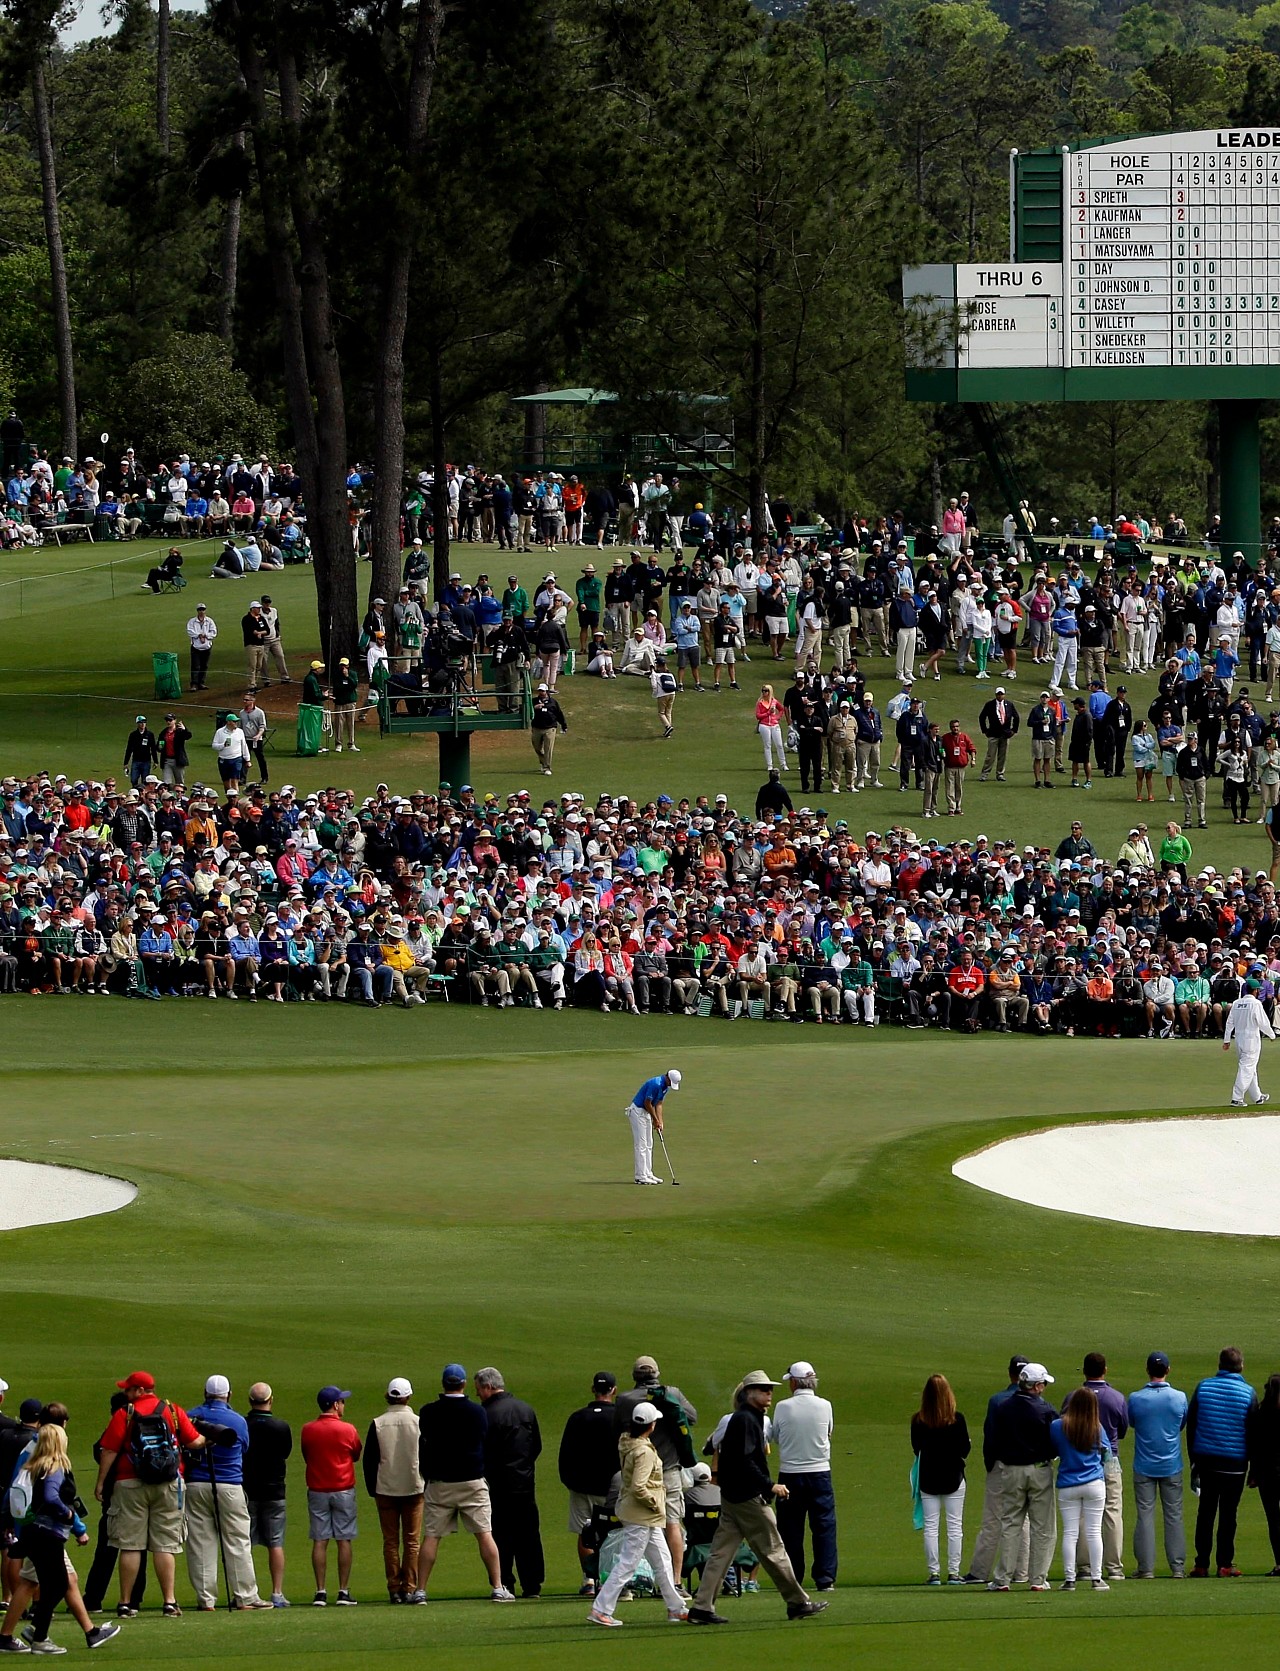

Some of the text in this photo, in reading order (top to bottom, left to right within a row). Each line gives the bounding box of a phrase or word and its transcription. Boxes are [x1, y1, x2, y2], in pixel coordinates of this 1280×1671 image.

[1111, 156, 1149, 168] HOLE
[1178, 156, 1182, 167] 1
[1193, 156, 1199, 167] 2
[1209, 156, 1215, 167] 3
[1225, 156, 1231, 167] 4
[1240, 156, 1246, 167] 5
[1256, 156, 1263, 167] 6
[1272, 156, 1278, 166] 7
[1117, 174, 1143, 185] PAR
[1177, 173, 1183, 184] 4
[1194, 173, 1199, 185] 5
[1209, 173, 1215, 184] 4
[1225, 173, 1231, 184] 3
[1240, 173, 1246, 184] 4
[1256, 173, 1262, 184] 3
[1272, 173, 1278, 184] 4
[1079, 191, 1183, 203] 3 SPIETH 3
[1079, 208, 1184, 221] 2 KAUFMAN 2
[1080, 226, 1199, 239] 1 LANGER 0 0
[1080, 244, 1198, 256] 1 MATSUYAMA 0 1
[1079, 262, 1214, 275] 0 DAY 0 0 0
[977, 271, 1042, 286] THRU 6
[1079, 279, 1215, 293] 0 JOHNSON D. 0 0 0
[972, 302, 1056, 314] OSE 4
[1079, 298, 1085, 310] 4
[1095, 298, 1125, 310] CASEY
[1178, 297, 1184, 309] 4
[1194, 297, 1199, 309] 3
[1209, 297, 1215, 309] 3
[1225, 297, 1231, 309] 3
[1240, 297, 1246, 308] 3
[1256, 296, 1262, 308] 3
[1272, 296, 1278, 308] 2
[972, 318, 1056, 330] CABRERA 3
[1079, 315, 1231, 328] 0 WILLETT 0 0 0 0
[1080, 332, 1232, 346] 1 SNEDEKER 1 1 2 2
[1081, 350, 1231, 364] 1 KJELDSEN 1 1 0 0
